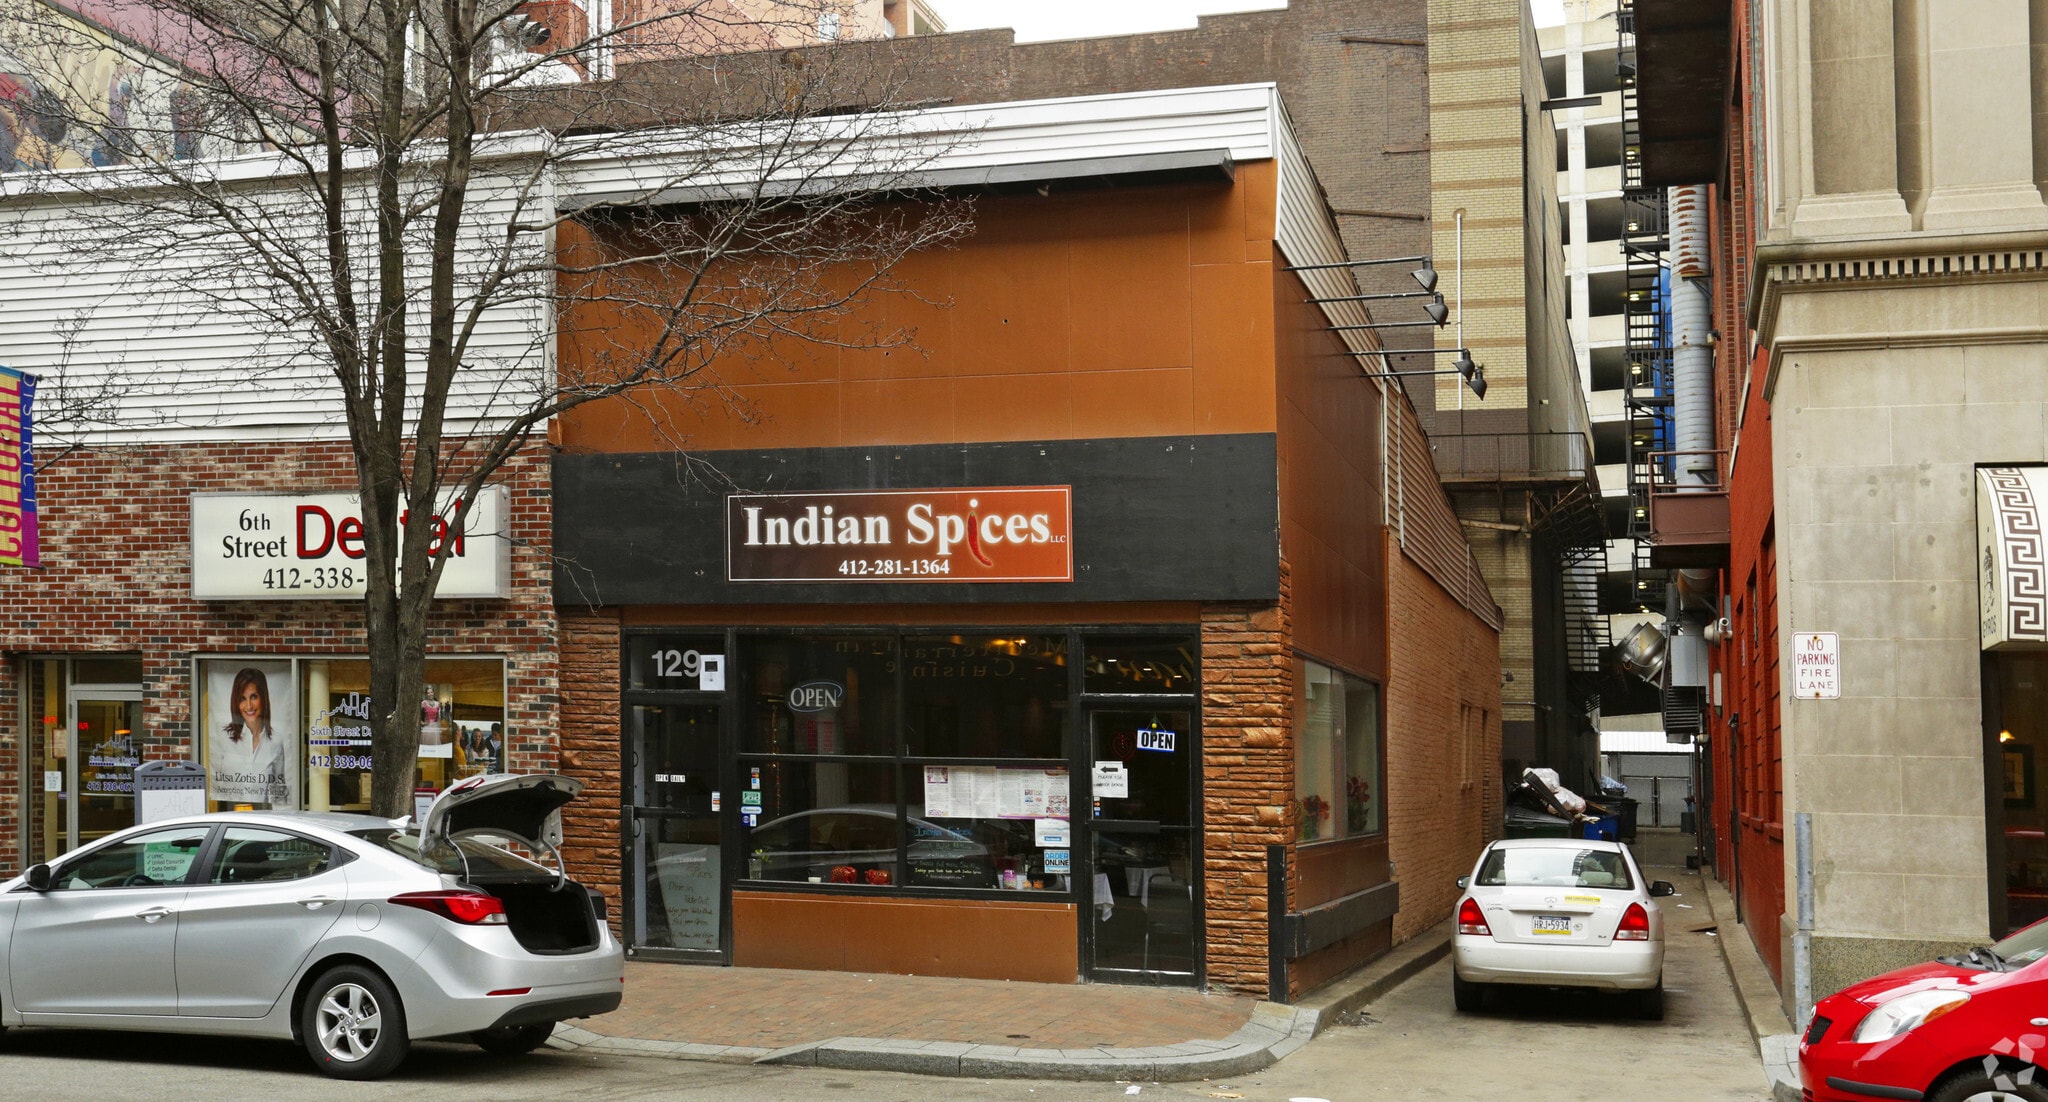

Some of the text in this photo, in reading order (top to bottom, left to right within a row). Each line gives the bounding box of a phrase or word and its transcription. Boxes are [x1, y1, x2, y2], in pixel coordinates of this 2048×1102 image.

[238, 508, 271, 531] 6th
[743, 498, 1066, 563] Indian Spices LLC
[222, 535, 288, 558] Street
[838, 559, 950, 575] 412-281-1364
[1807, 639, 1824, 651] NO
[651, 649, 701, 678] 129
[1797, 653, 1835, 665] PARKING
[1801, 668, 1832, 677] FIRE
[1800, 681, 1834, 689] LANE
[790, 687, 838, 708] OPEN
[311, 726, 332, 736] Sixth
[333, 725, 360, 737] Street
[1141, 732, 1173, 750] OPEN
[310, 755, 331, 768] 412
[215, 772, 234, 783] Litsa
[235, 772, 257, 783] Zotis
[87, 781, 101, 791] 412
[245, 786, 260, 795] New
